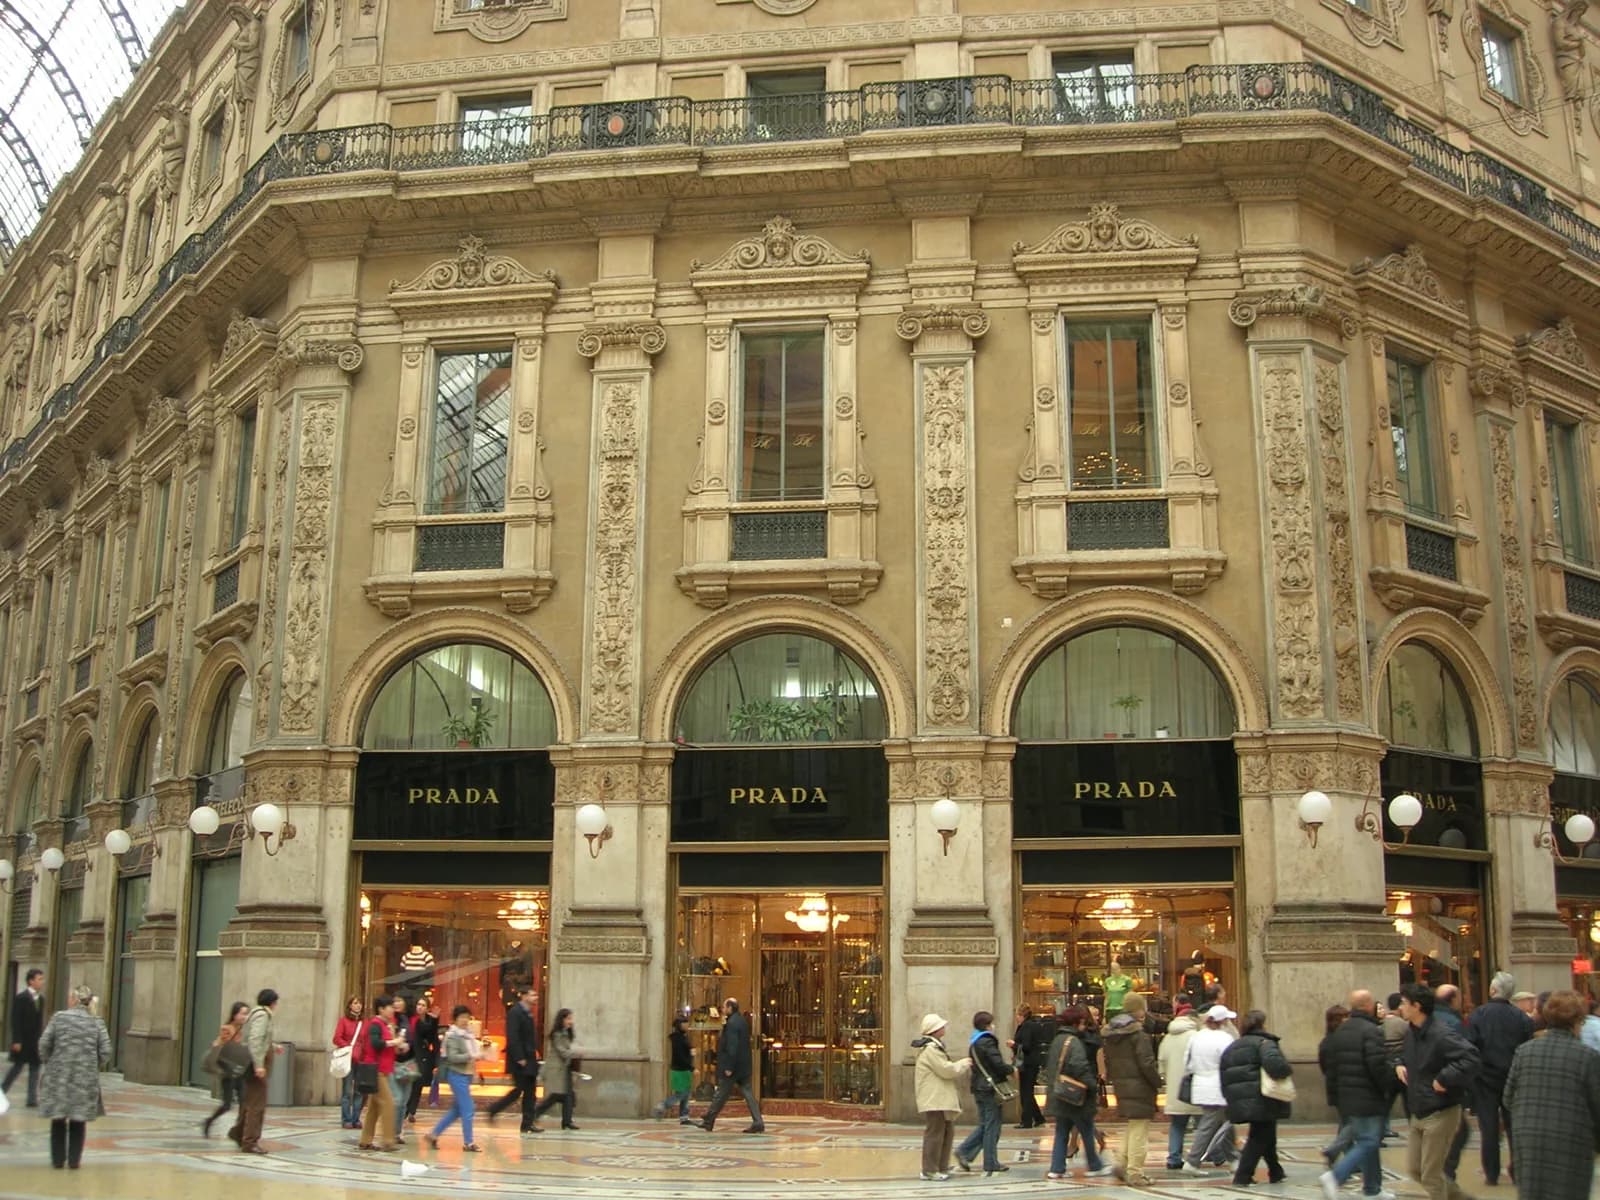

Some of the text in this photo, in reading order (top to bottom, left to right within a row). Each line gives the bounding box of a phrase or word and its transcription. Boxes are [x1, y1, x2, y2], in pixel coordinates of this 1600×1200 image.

[408, 788, 500, 804] PRADA
[730, 787, 828, 804] PRADA
[1074, 781, 1177, 799] PRADA
[1402, 791, 1457, 812] ADA
